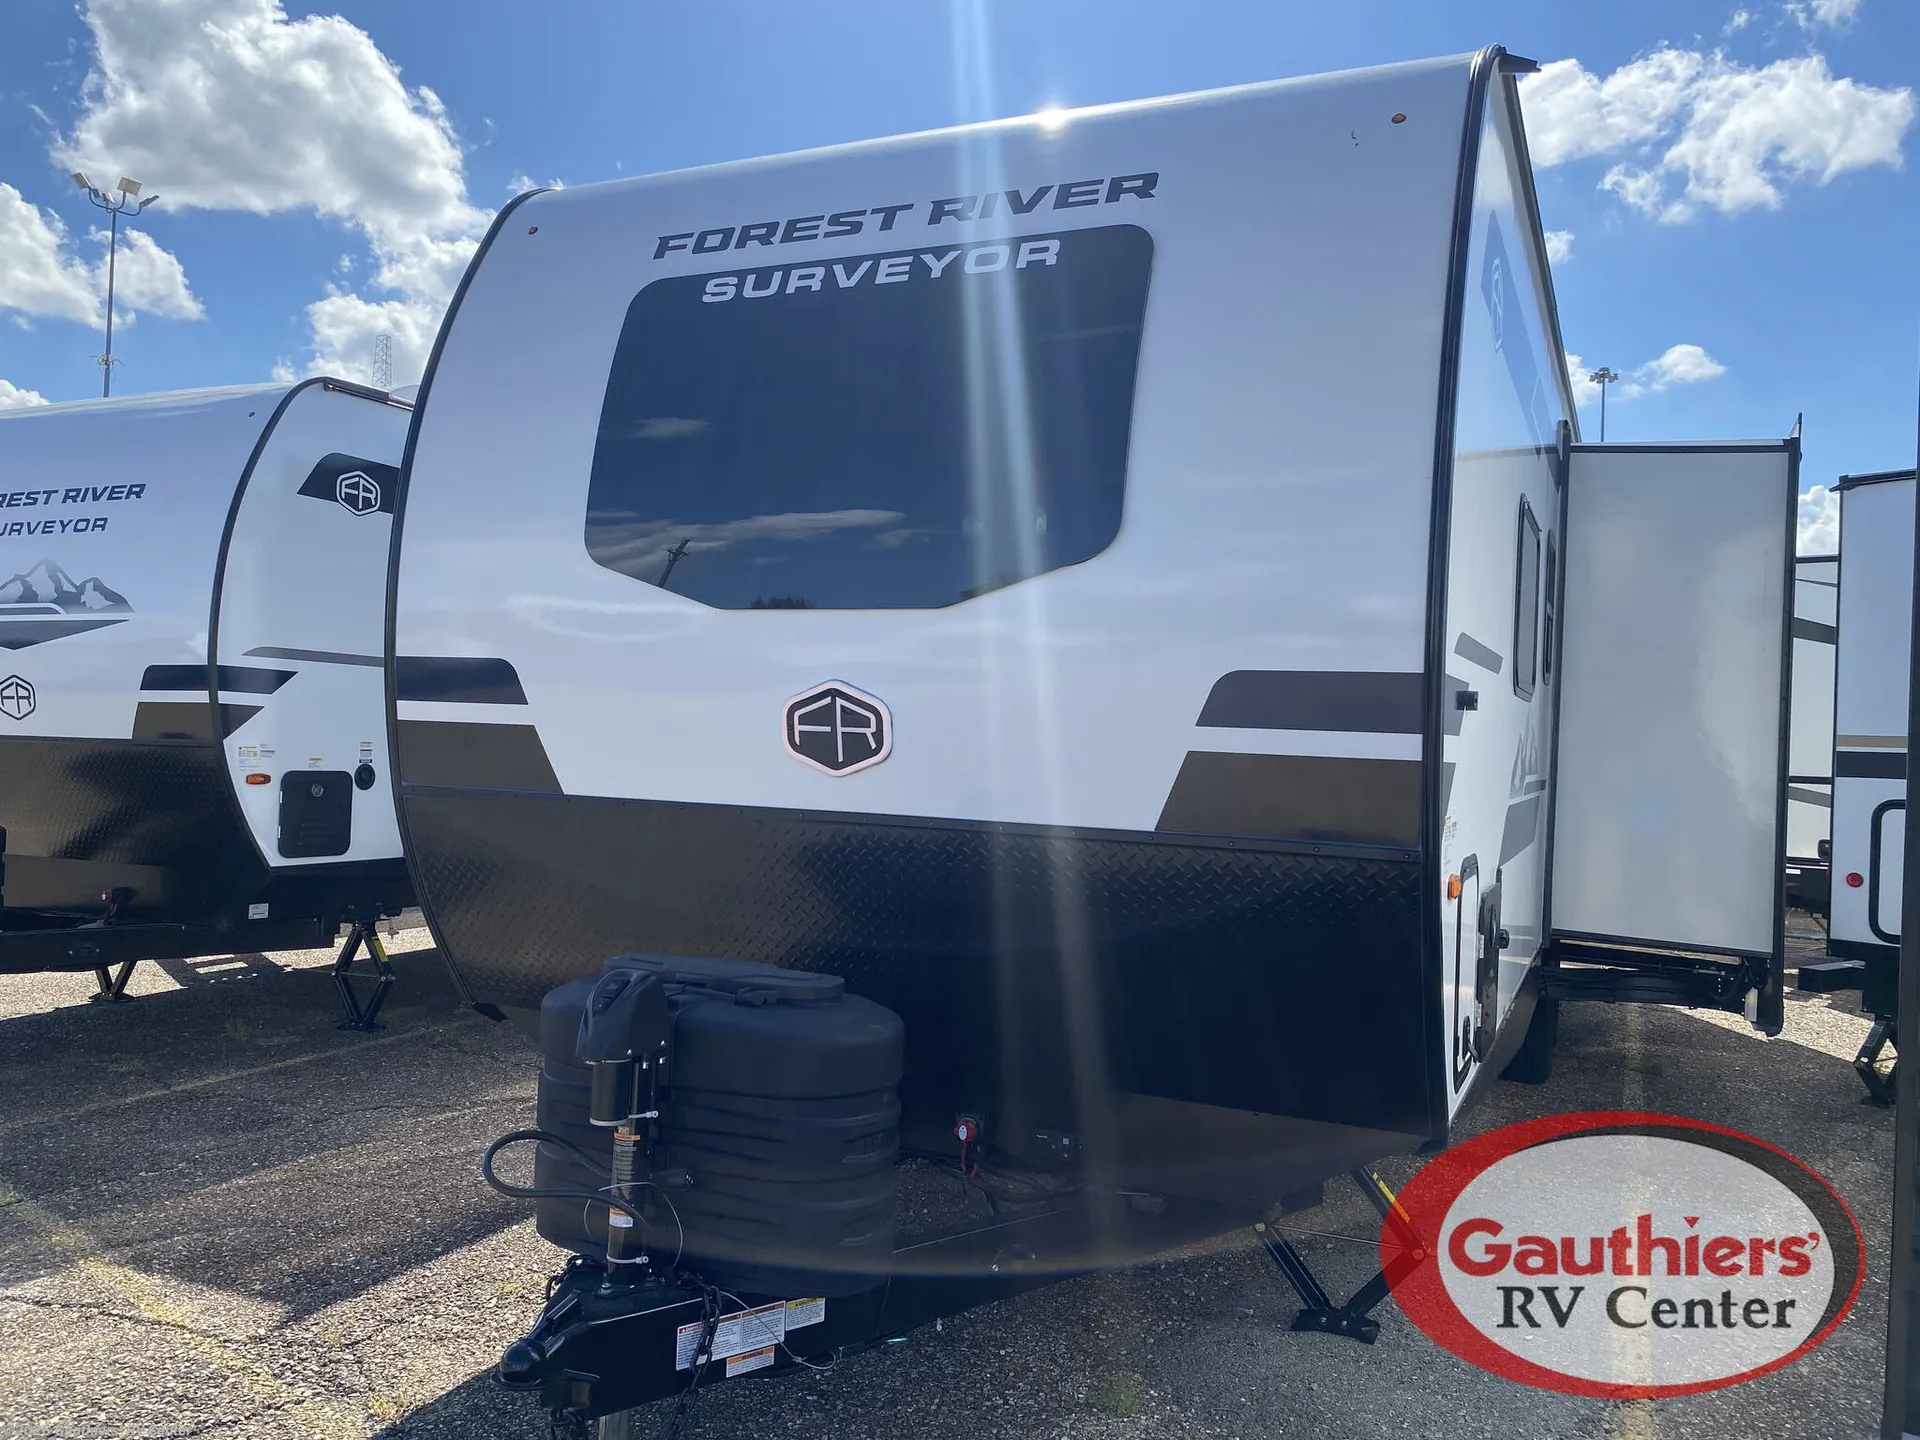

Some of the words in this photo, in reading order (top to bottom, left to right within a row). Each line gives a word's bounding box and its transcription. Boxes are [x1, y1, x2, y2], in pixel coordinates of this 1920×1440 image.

[652, 203, 914, 260] FOREST
[927, 171, 1159, 226] RIVER
[702, 239, 1061, 303] SURVEYOR
[61, 483, 146, 504] RIVER
